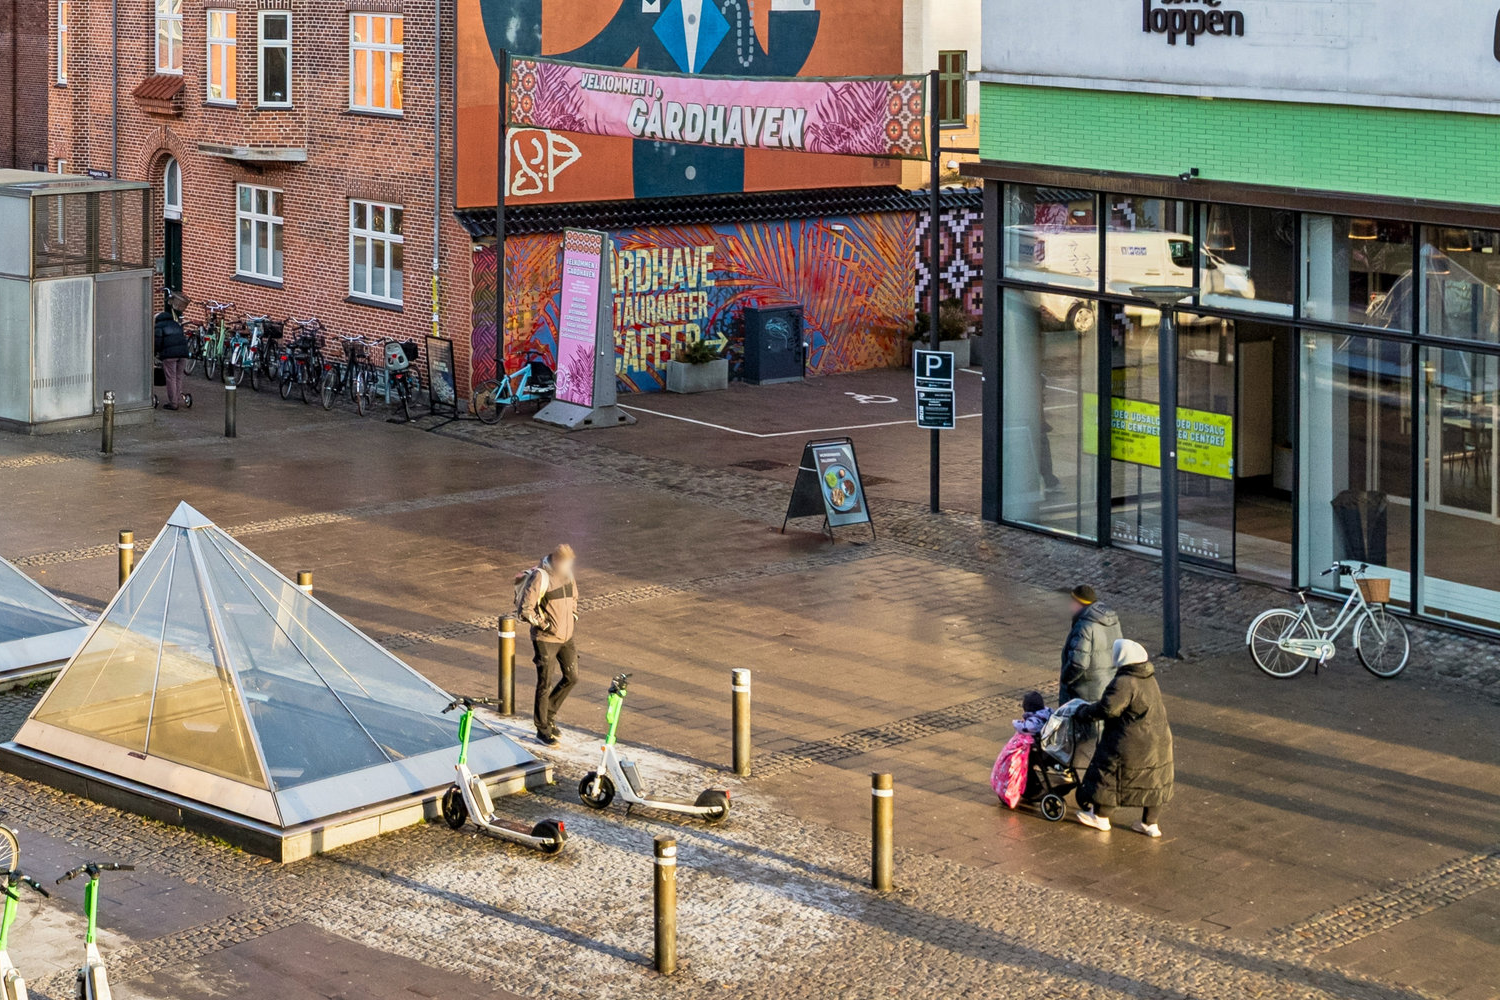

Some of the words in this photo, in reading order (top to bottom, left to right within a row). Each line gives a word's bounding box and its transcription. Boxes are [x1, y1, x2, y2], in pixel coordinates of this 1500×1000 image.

[581, 72, 646, 96] VELKOMMEN
[647, 79, 654, 97] I
[626, 87, 807, 149] GÅRDHAVEN
[614, 291, 708, 326] TAURANTER
[925, 354, 942, 377] P
[1114, 410, 1128, 419] DER
[1177, 430, 1188, 440] ER
[1190, 431, 1225, 447] CENTRET
[1194, 421, 1225, 436] UDSALG
